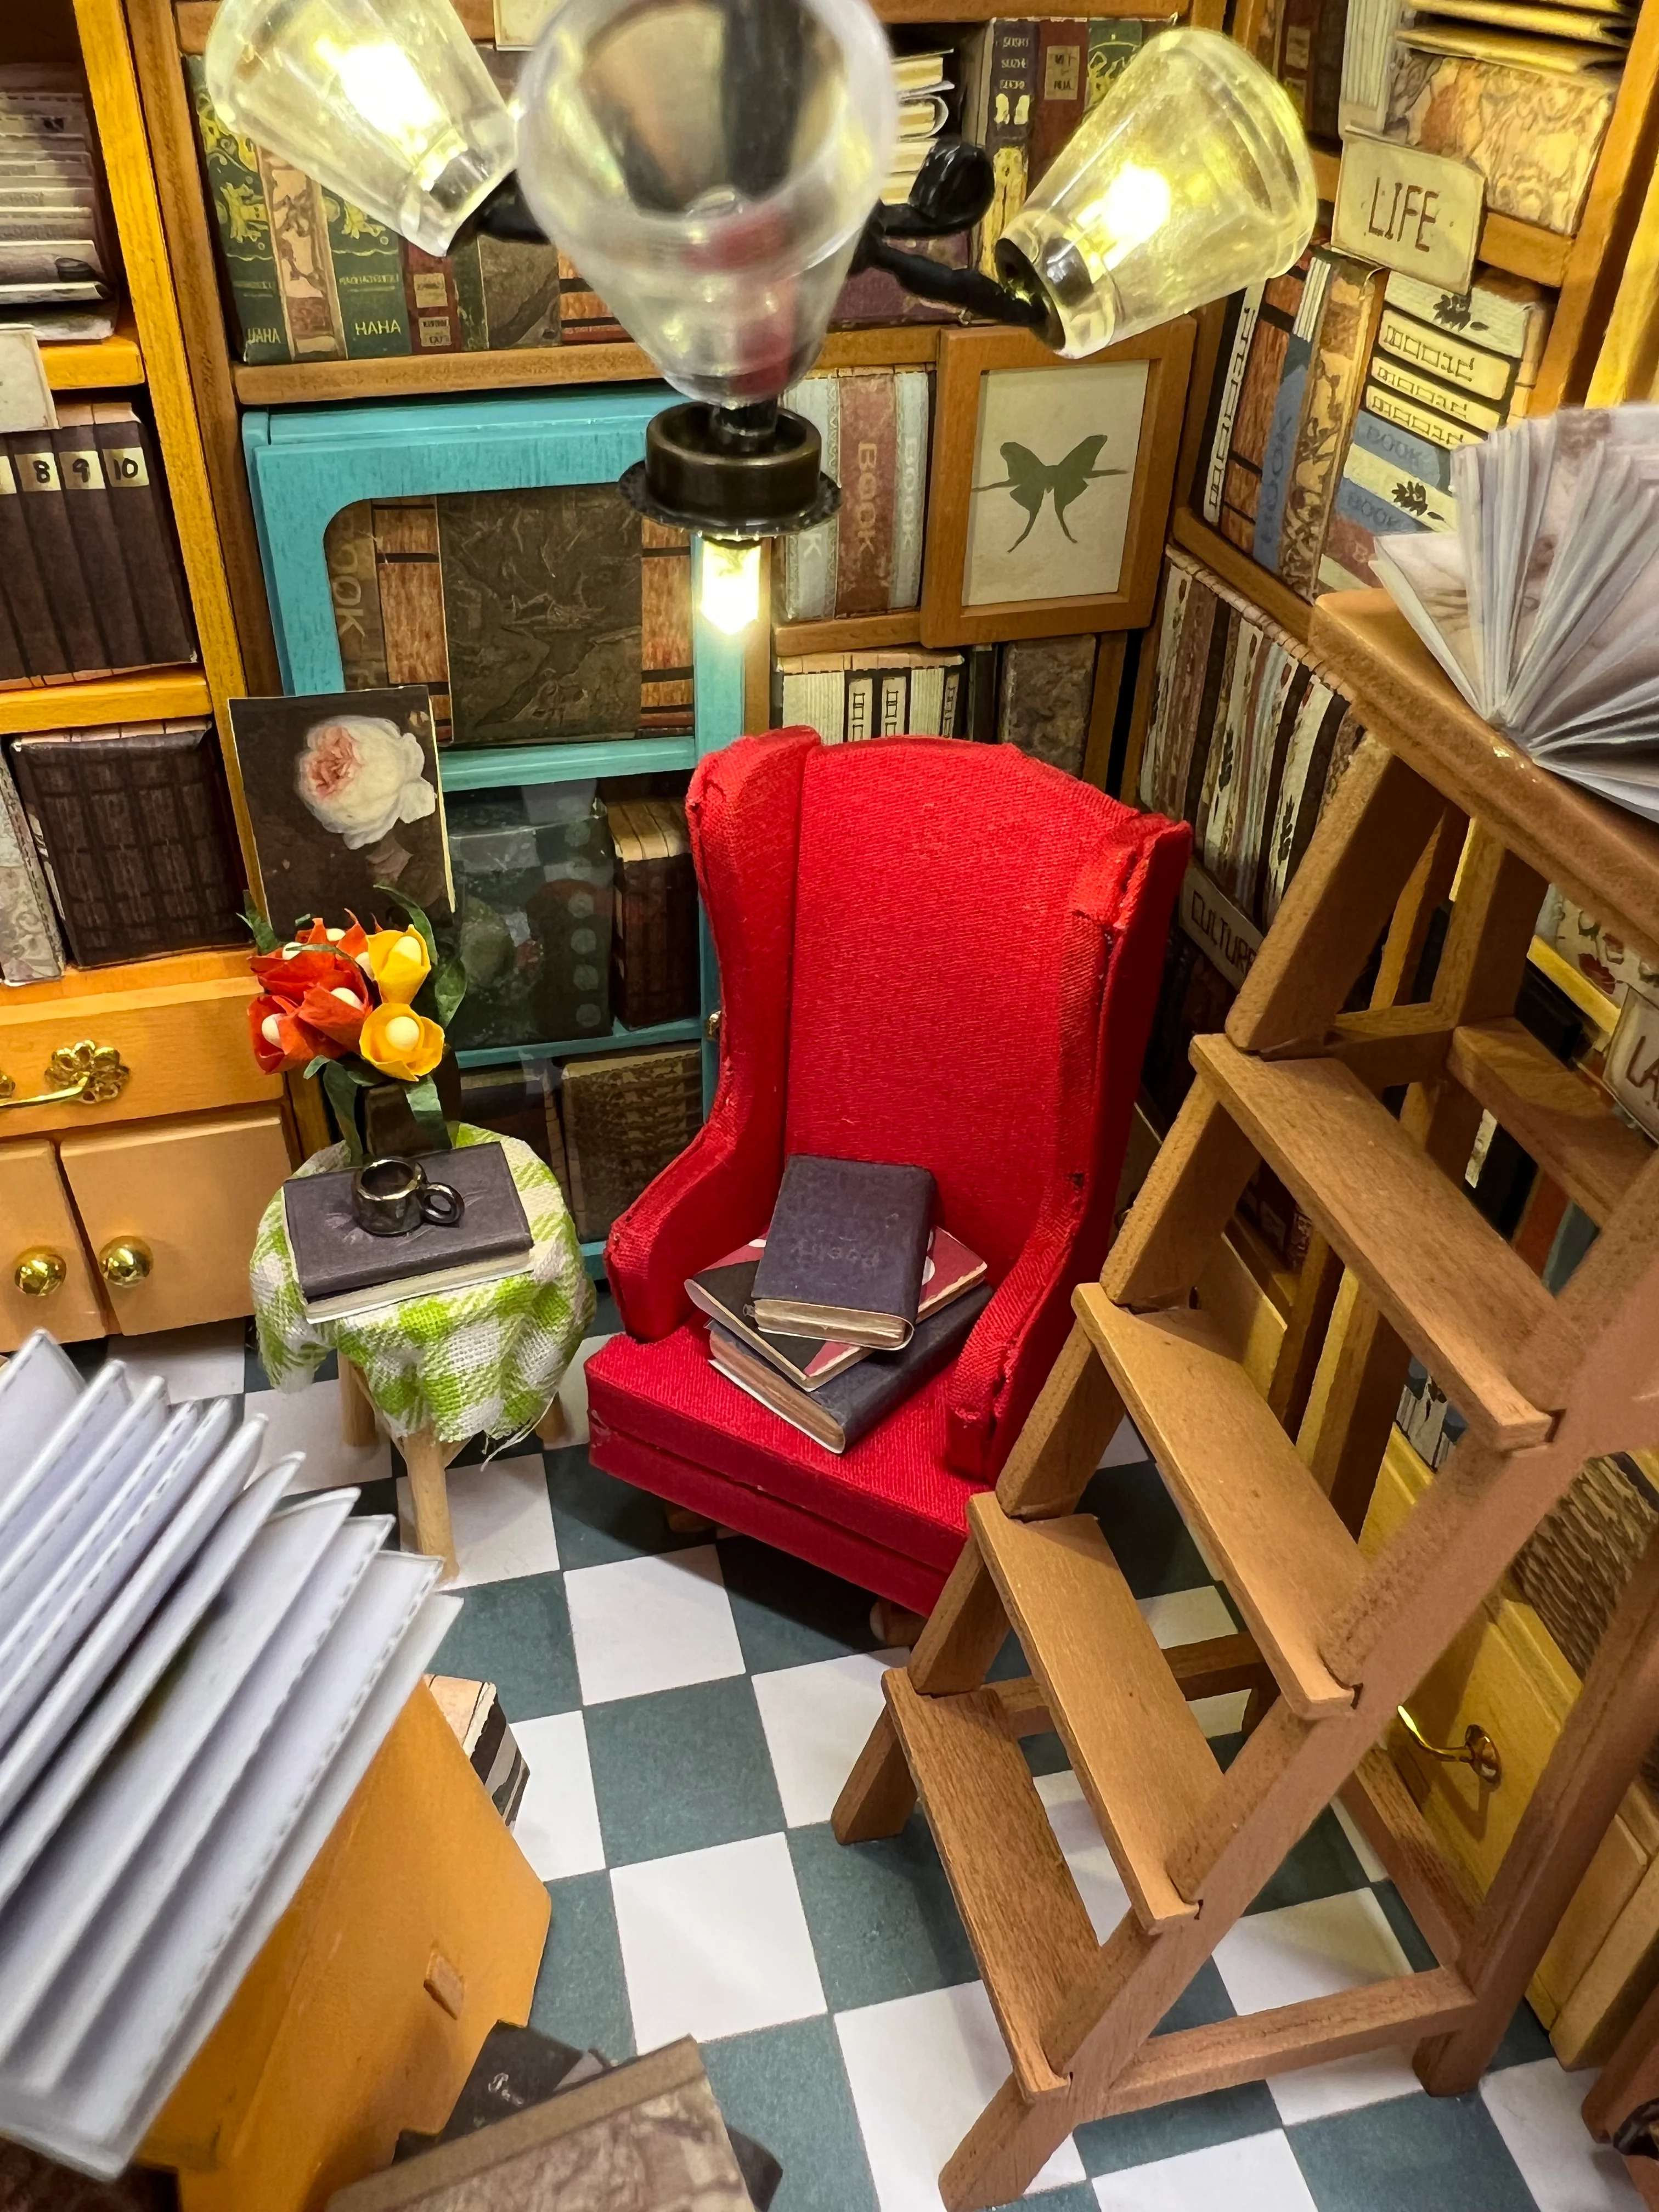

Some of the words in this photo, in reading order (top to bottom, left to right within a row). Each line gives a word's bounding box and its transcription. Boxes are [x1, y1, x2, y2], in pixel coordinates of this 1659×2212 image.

[1368, 177, 1440, 252] LIFE
[354, 319, 402, 336] HAHA
[33, 460, 50, 483] 8
[72, 458, 91, 483] 9
[113, 458, 138, 481] 10
[857, 442, 877, 555] BOOK
